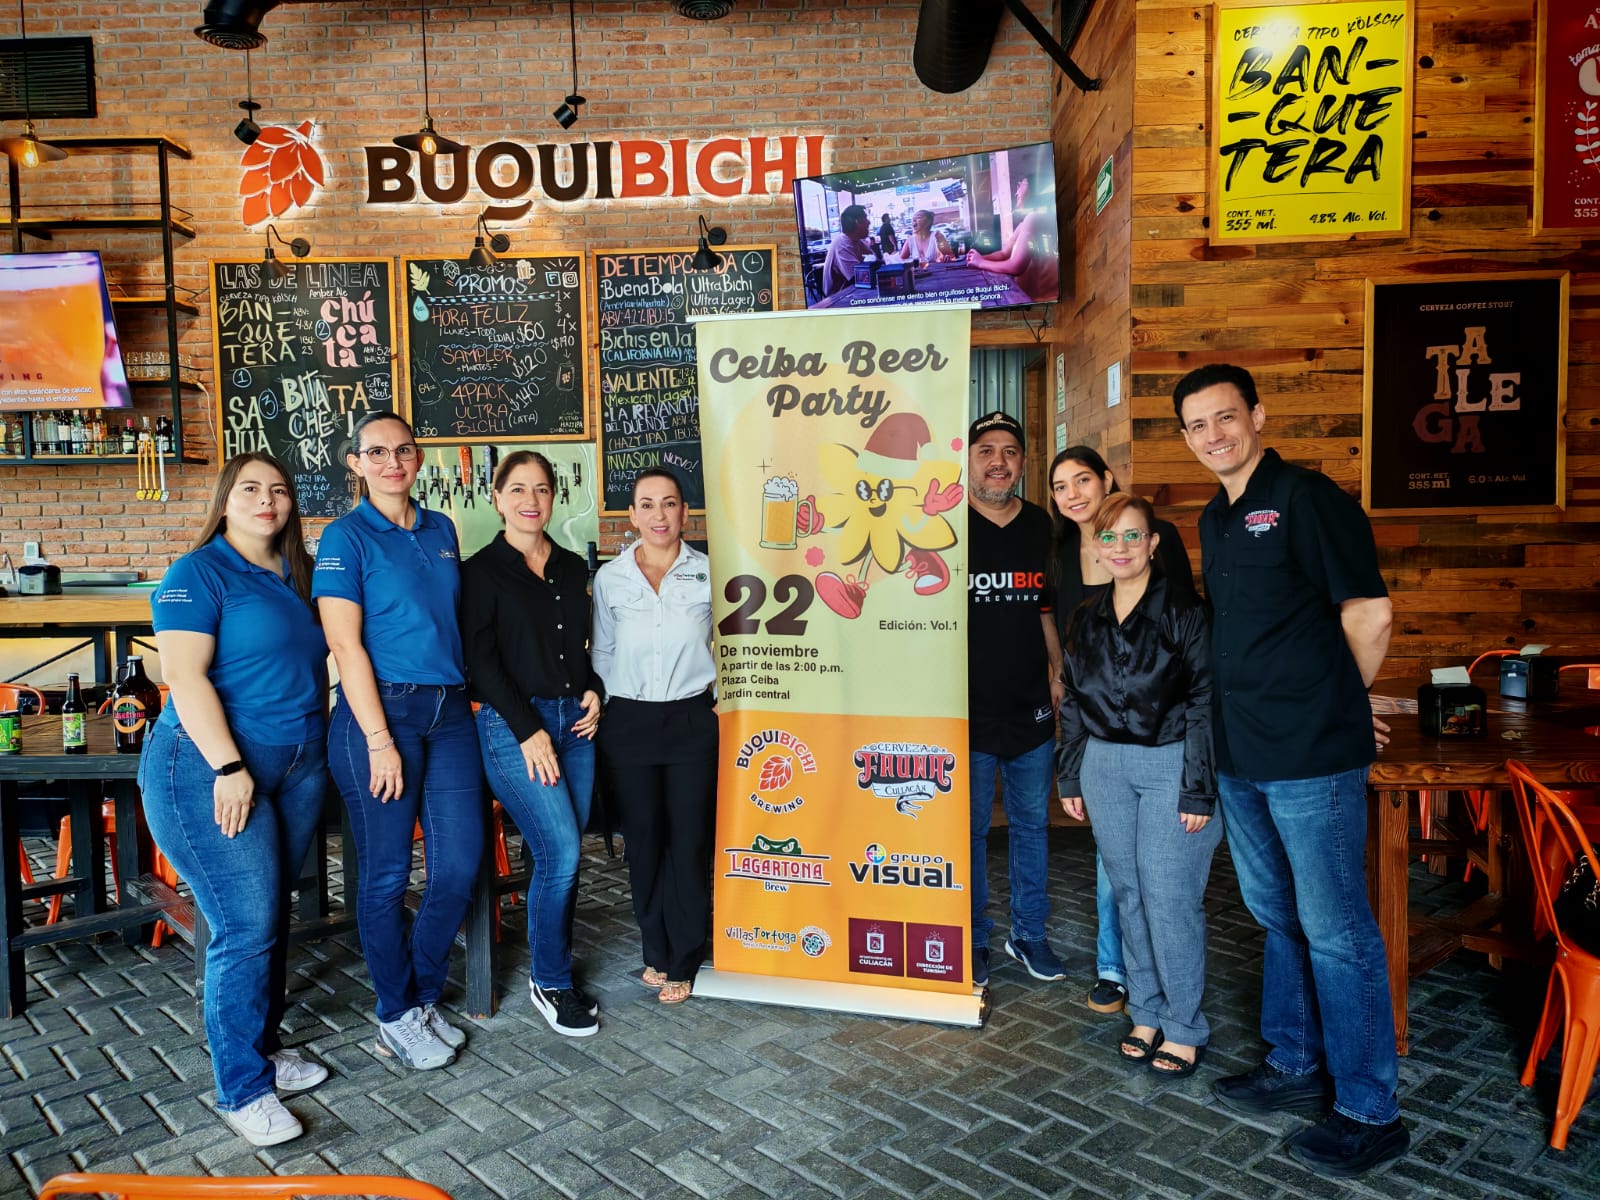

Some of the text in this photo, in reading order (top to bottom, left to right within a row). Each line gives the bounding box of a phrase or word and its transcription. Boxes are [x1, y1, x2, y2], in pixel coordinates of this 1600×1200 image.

[1234, 13, 1405, 41] CERA TIPO KÖLSCH
[1225, 36, 1399, 100] BAN-
[1220, 135, 1383, 192] TERA
[364, 136, 824, 221] BUQUIBICHI
[1226, 209, 1276, 218] CONT. NET.
[1343, 212, 1364, 223] Alc.
[1369, 211, 1388, 221] Vol.
[1574, 208, 1598, 218] 355
[1226, 218, 1252, 231] 355
[600, 252, 738, 278] DE TEMPODA
[220, 264, 261, 289] LAS
[306, 263, 381, 288] LINEA
[455, 273, 531, 294] PROMOS
[691, 274, 753, 294] Ultra Bichi
[220, 292, 253, 303] CERVEZA
[254, 293, 270, 303] TIPO
[309, 289, 334, 298] Amber
[601, 276, 684, 300] Buena Bola
[850, 298, 866, 306] Como
[867, 296, 895, 304] sonorense
[939, 288, 965, 298] orgulloso
[975, 286, 992, 294] Buqui
[980, 293, 1003, 301] Sonora.
[691, 293, 719, 306] (Ultra
[721, 292, 755, 310] Lager)
[1420, 301, 1514, 312] CERVEZA COFFEE STOUT
[431, 303, 534, 328] HORA FELIZ
[336, 324, 381, 347] ca
[516, 320, 546, 342] $60
[600, 328, 648, 351] Bichis
[649, 331, 672, 348] en
[674, 326, 693, 347] la
[223, 341, 297, 365] TERA
[302, 345, 313, 355] 23
[322, 339, 363, 368] ta
[602, 347, 662, 362] (CALIFORNIA
[442, 348, 517, 365] SAMPLER
[512, 347, 548, 379] $120
[710, 340, 949, 383] Ceiba Beer
[365, 377, 390, 388] Coffee
[605, 368, 680, 393] VALIENTE
[1455, 368, 1521, 413] LE
[328, 382, 371, 415] TA
[368, 387, 389, 398] Stout
[451, 382, 540, 412] 4PACK $140
[604, 386, 697, 409] (Mexican Lager)
[228, 396, 265, 430] SA
[455, 403, 509, 420] ULTRA
[632, 396, 700, 420] REVANCHA
[767, 384, 891, 429] Party
[289, 410, 335, 438] CHE
[451, 411, 539, 435] BICHI (LATA)
[605, 416, 671, 436] DEL DUENDE
[1412, 401, 1486, 454] GA
[224, 430, 277, 460] HUA
[608, 431, 667, 451] (HAZY IPA)
[298, 437, 332, 471] RA
[607, 450, 661, 471] INVASION
[314, 474, 327, 482] IPA
[609, 471, 637, 483] (HAZY
[1409, 479, 1430, 490] 355
[968, 572, 1044, 595] QUIBIC
[717, 574, 815, 637] 22
[975, 594, 1039, 603] BREWING
[879, 619, 958, 632] Edición: Vol.1
[720, 643, 819, 658] De noviembre
[721, 660, 844, 675] A partir de las 2:00 p.m.
[721, 674, 779, 687] Plaza Ceiba
[722, 688, 790, 701] Jardín central
[736, 730, 817, 774] BUQUIBICHI
[877, 743, 930, 753] CERVEZA
[750, 793, 804, 813] BREWING
[731, 853, 823, 880] LAGARTONA
[890, 853, 944, 866] grupo
[849, 862, 953, 889] visual
[764, 881, 788, 893] Brew
